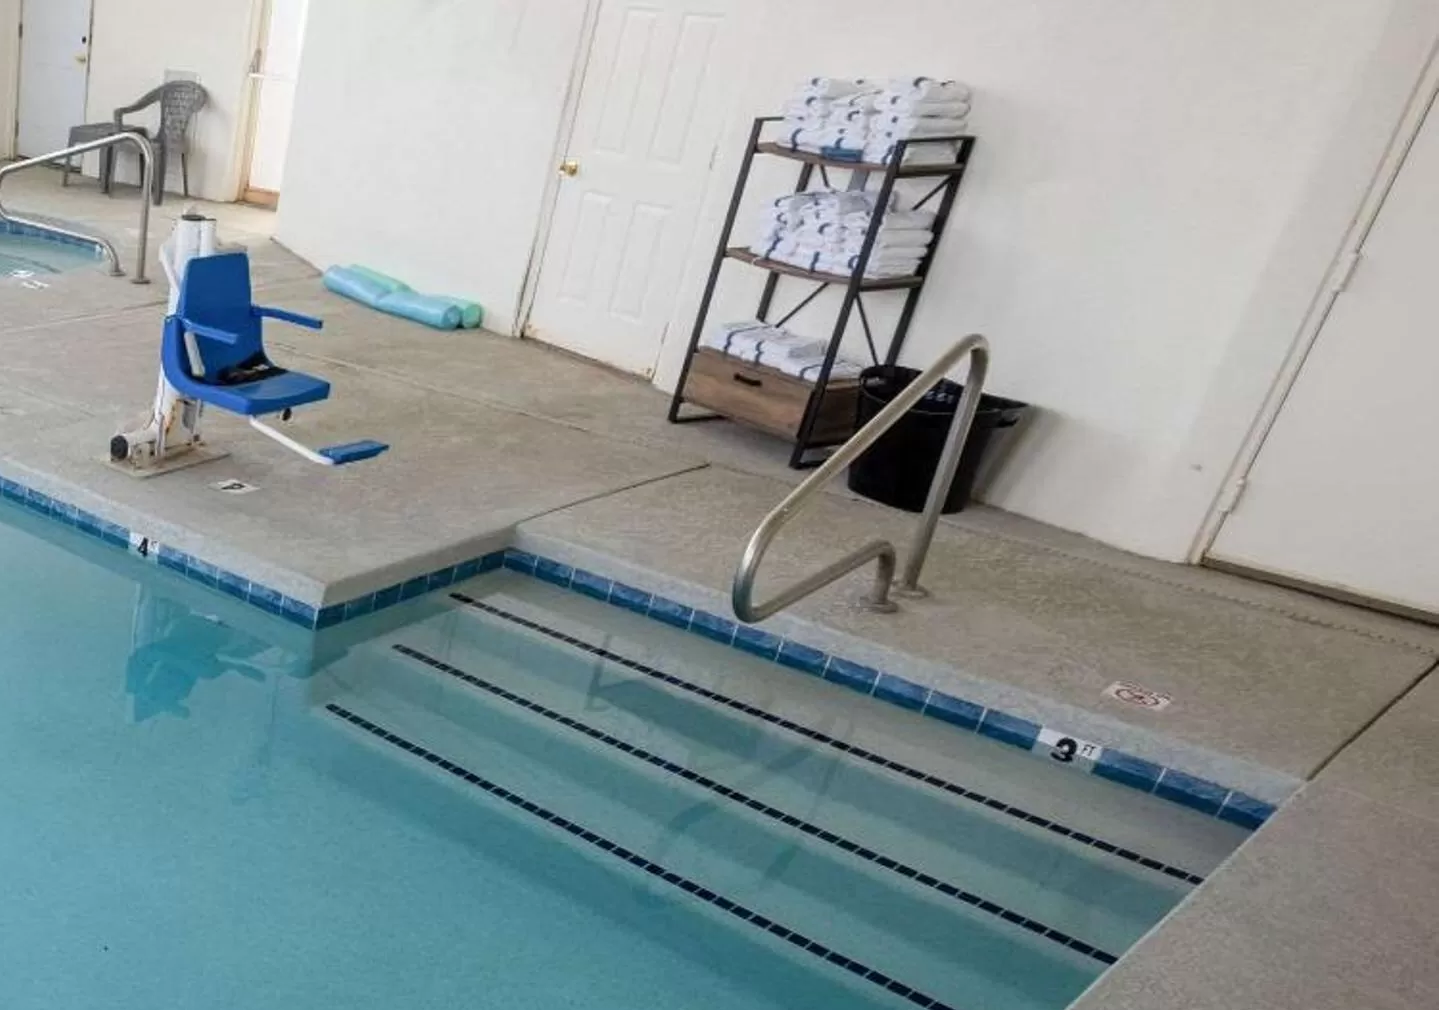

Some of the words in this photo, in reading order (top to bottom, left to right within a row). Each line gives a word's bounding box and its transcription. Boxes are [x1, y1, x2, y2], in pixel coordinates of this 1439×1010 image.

[137, 536, 148, 558] 4
[1049, 737, 1078, 763] 3
[1081, 743, 1097, 757] FT
